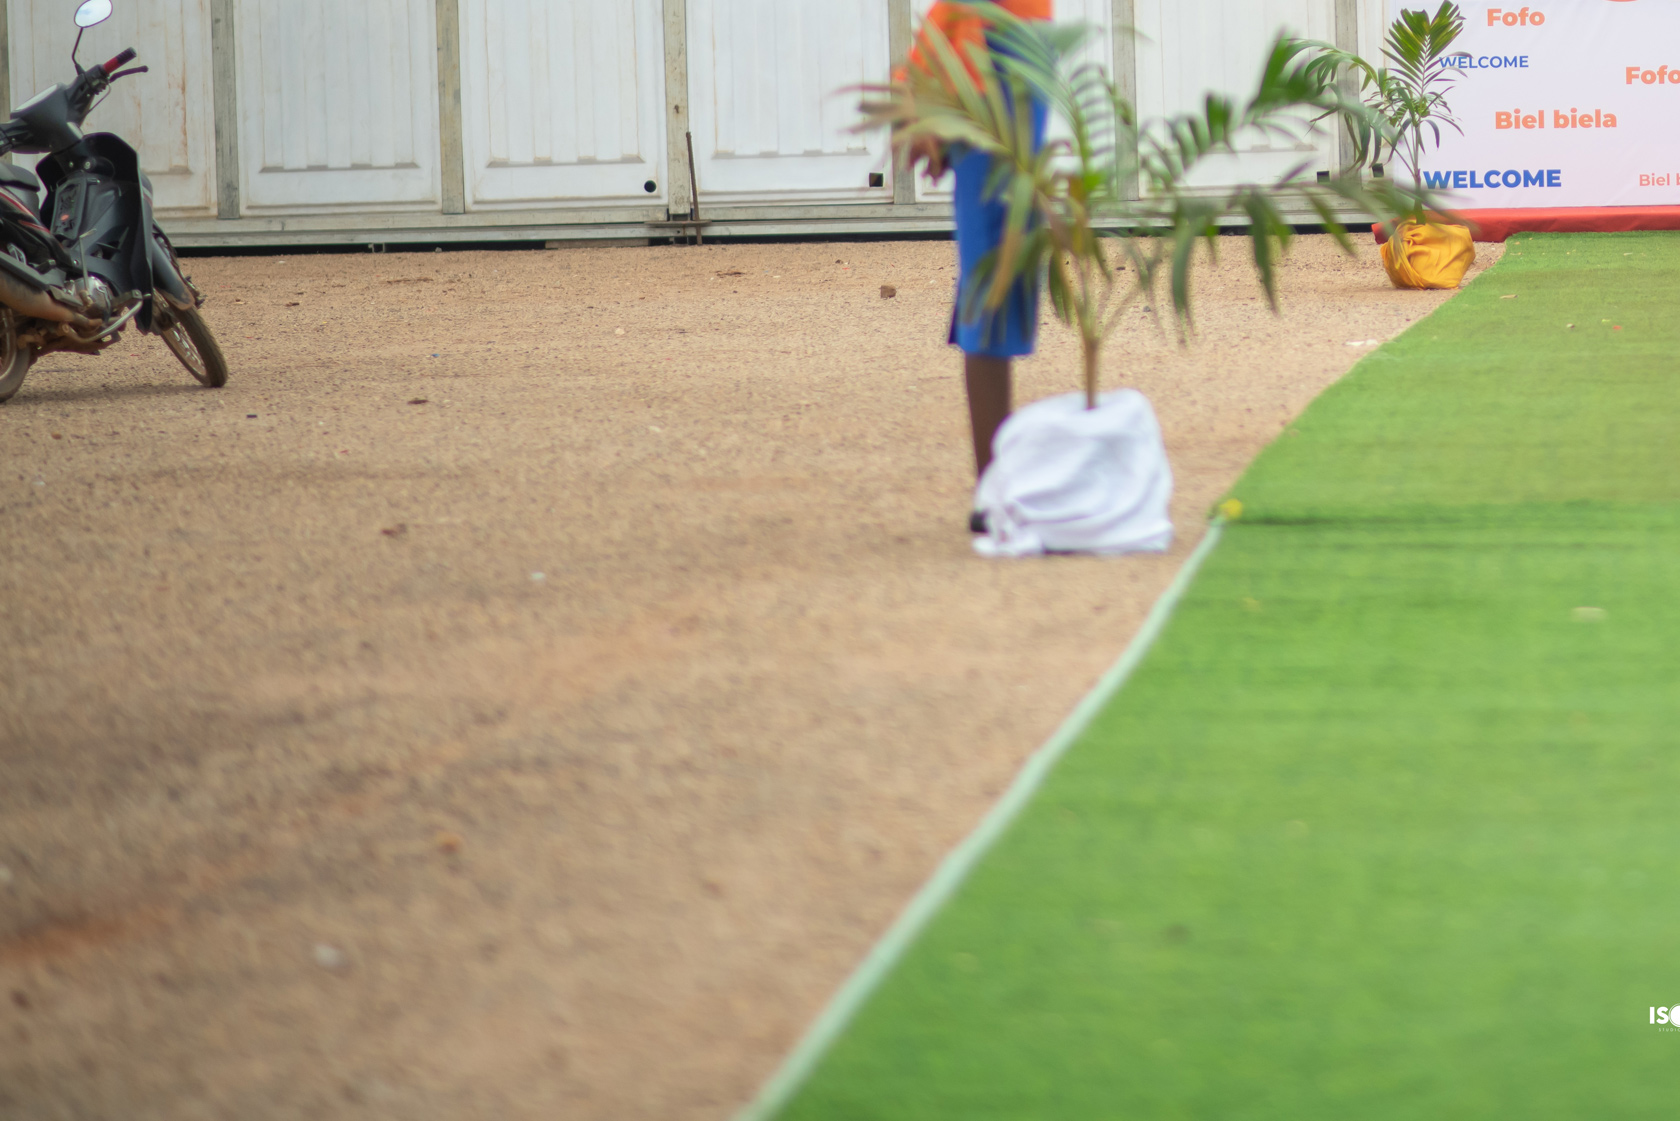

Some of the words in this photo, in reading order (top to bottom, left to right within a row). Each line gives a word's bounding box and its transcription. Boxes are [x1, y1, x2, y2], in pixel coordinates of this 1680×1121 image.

[1487, 6, 1545, 27] Fofo
[1439, 55, 1529, 69] WELCOME
[1495, 108, 1545, 130] Biel
[1553, 107, 1617, 129] biela
[1423, 169, 1562, 189] WELCOME
[1639, 172, 1671, 187] Biel
